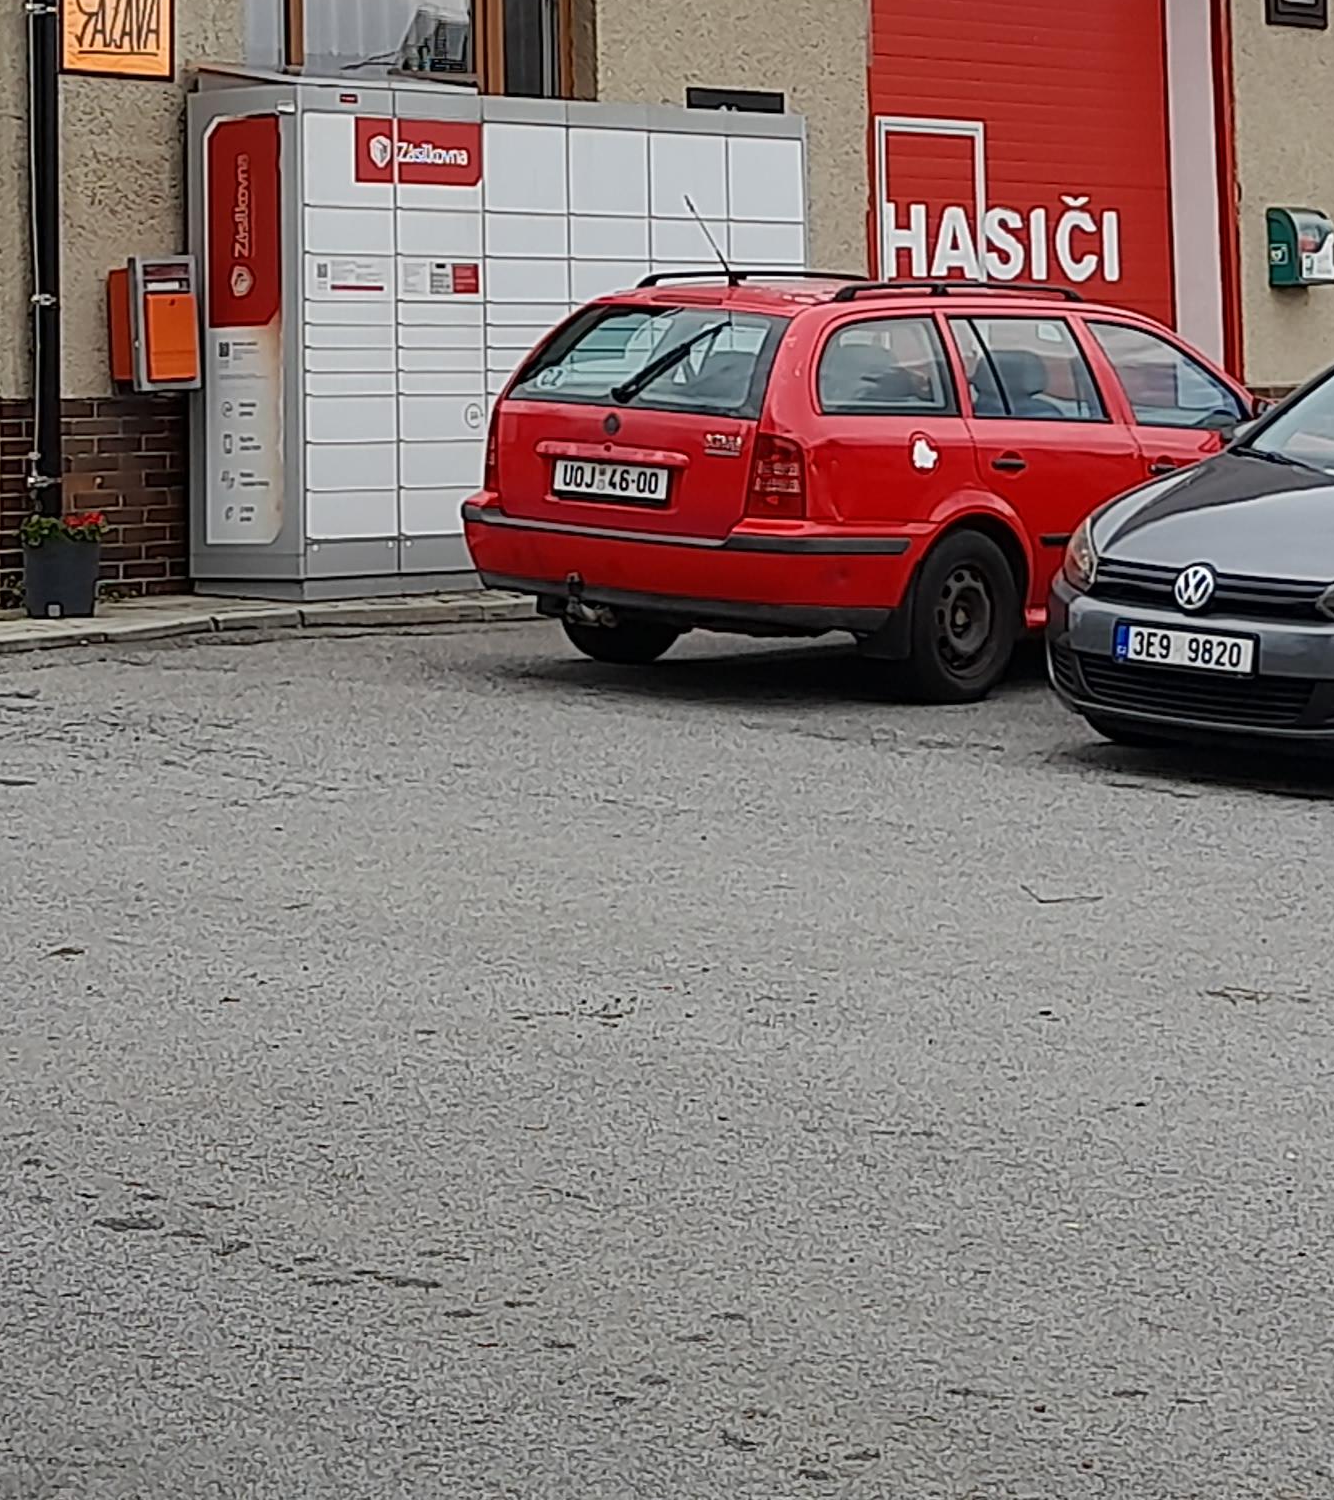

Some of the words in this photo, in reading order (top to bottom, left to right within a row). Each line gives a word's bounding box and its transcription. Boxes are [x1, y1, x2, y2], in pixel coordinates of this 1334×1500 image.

[884, 195, 1122, 283] HASIČI
[562, 463, 597, 489] UOJ
[608, 467, 659, 495] 46-00
[1133, 631, 1172, 660] 3E9
[1187, 637, 1242, 668] 9820
